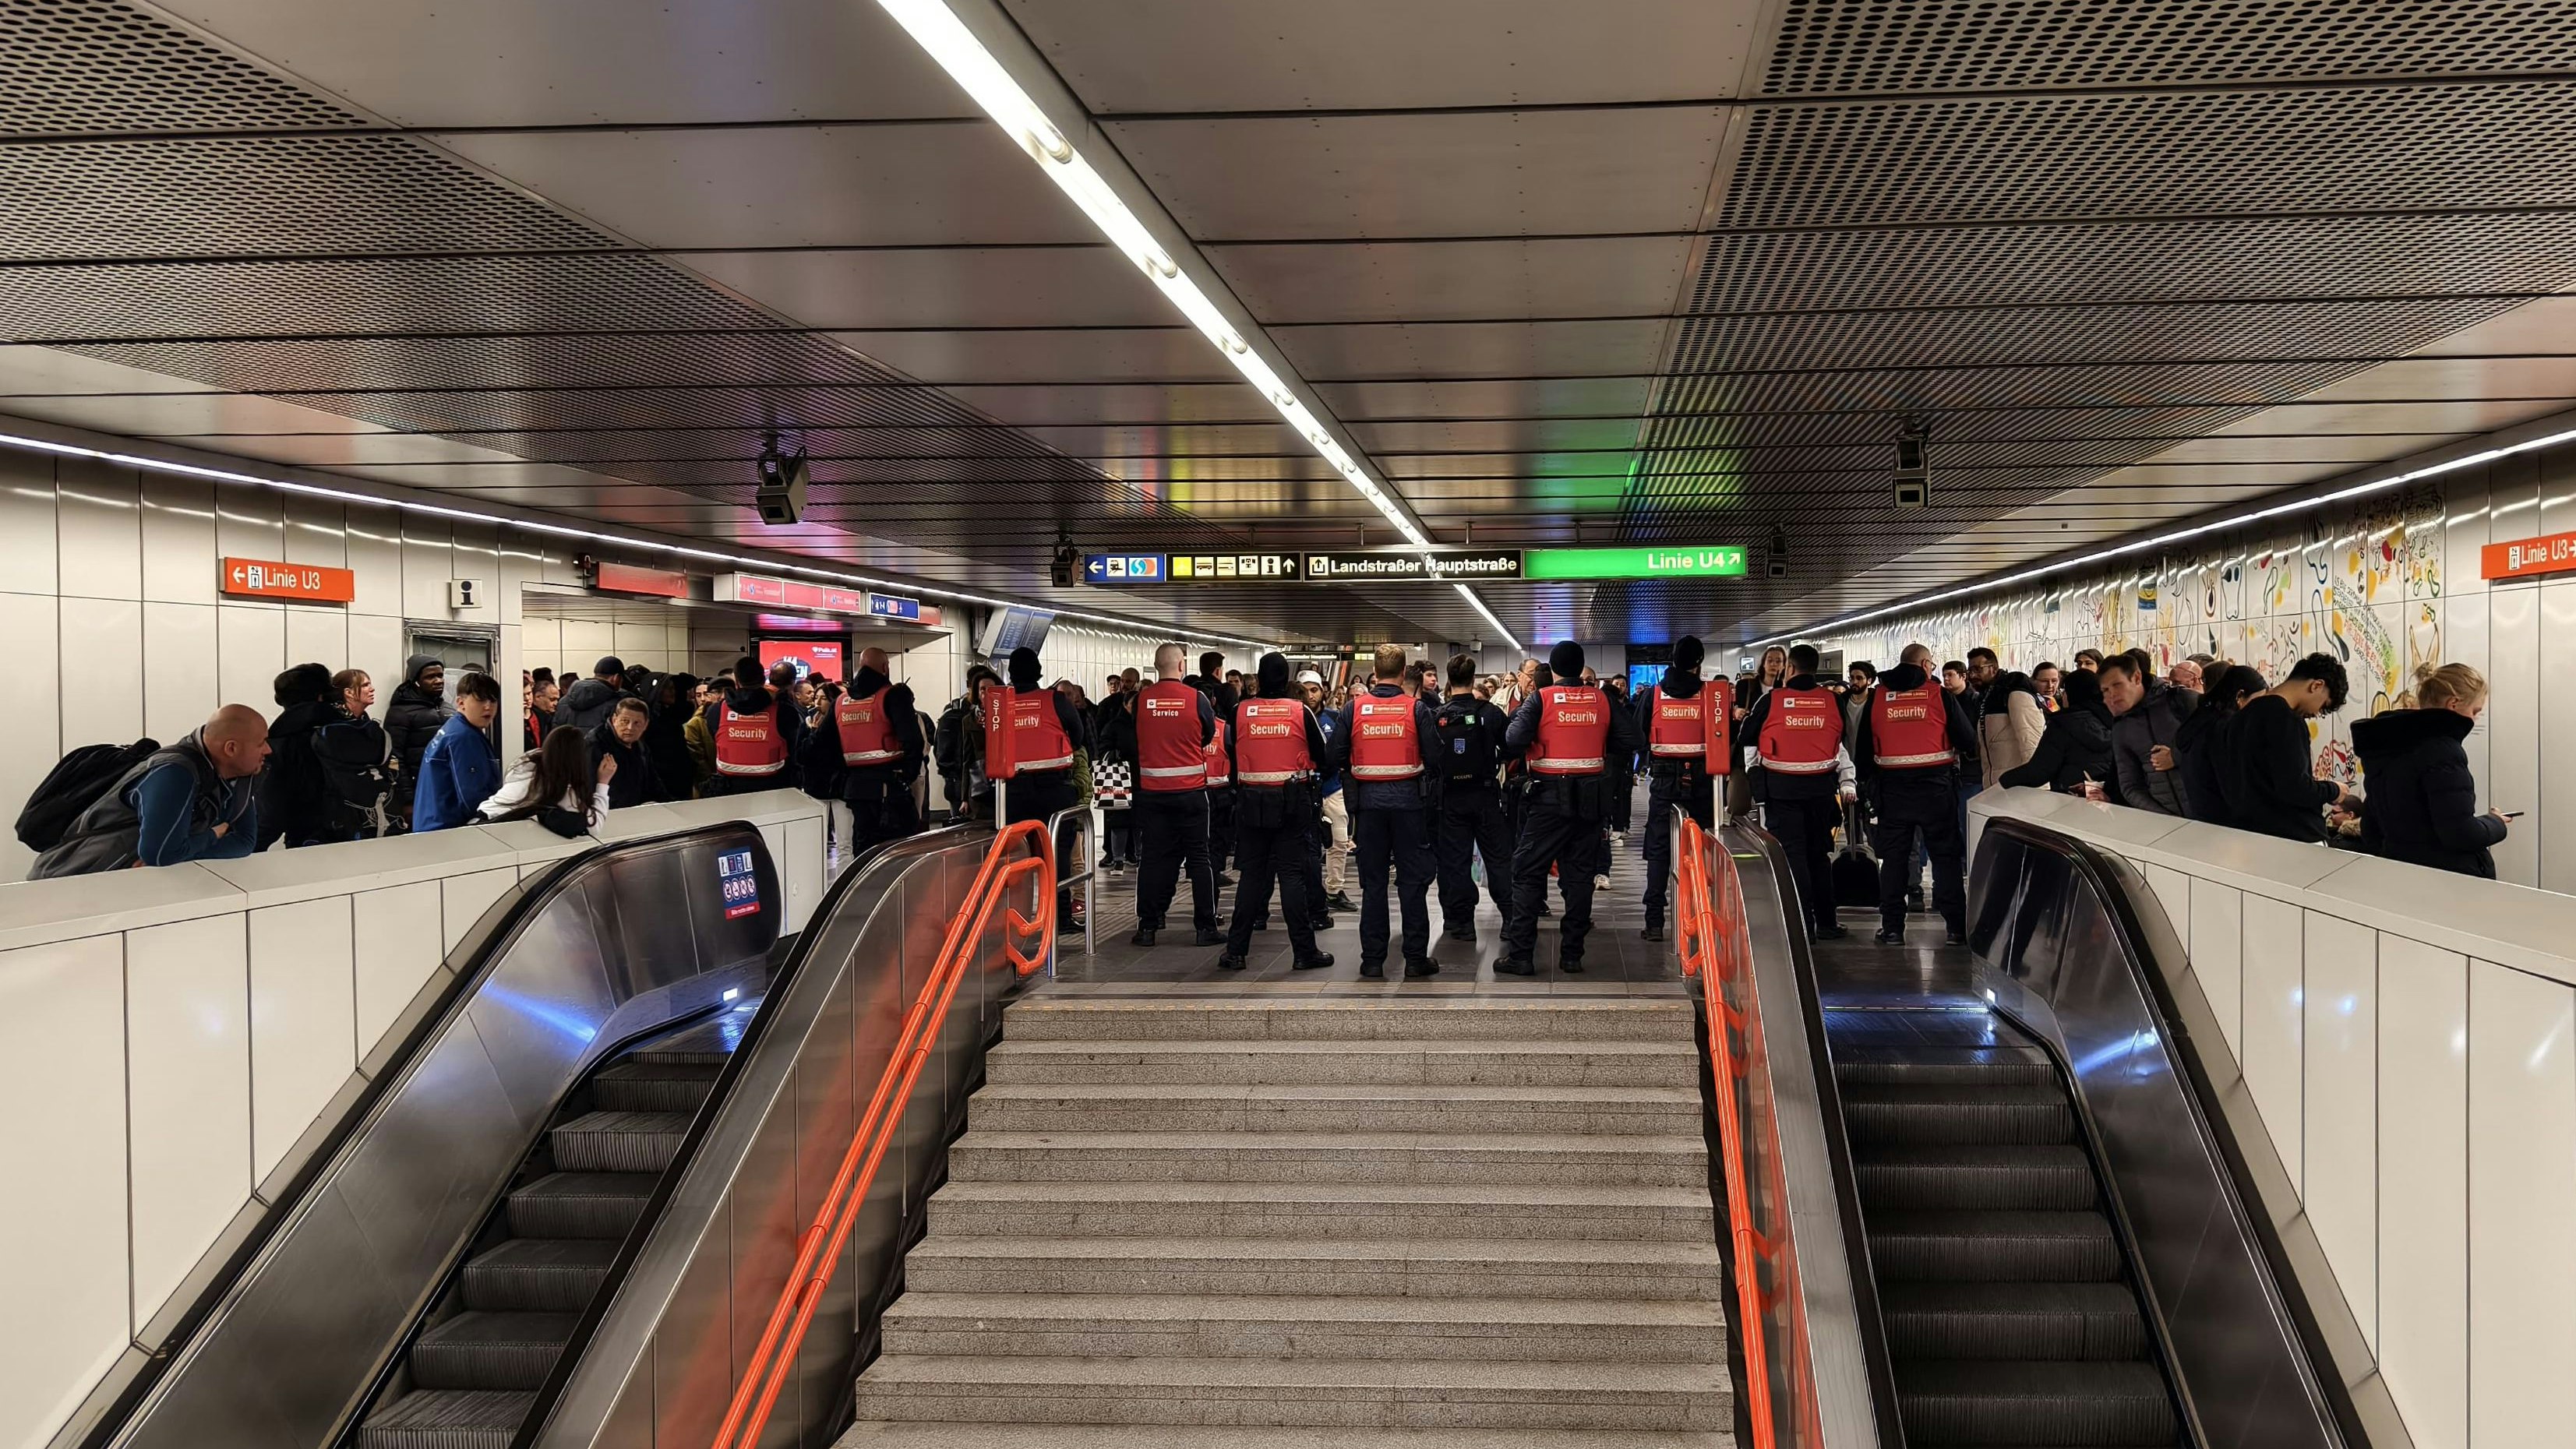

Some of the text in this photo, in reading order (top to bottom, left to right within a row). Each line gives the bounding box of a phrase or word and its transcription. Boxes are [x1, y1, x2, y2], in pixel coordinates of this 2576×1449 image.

[2521, 539, 2567, 565] Linie U3
[1331, 557, 1517, 574] Landstraßer Hauptstraße
[1648, 552, 1724, 569] Linie U4
[264, 567, 320, 590] Linie U3
[842, 710, 870, 722] Security
[1558, 710, 1597, 724] Security
[1662, 706, 1699, 718] Security
[1887, 706, 1926, 718] Security
[1015, 716, 1039, 727] curity
[1786, 715, 1824, 728] Security
[729, 727, 767, 740] Security
[1250, 723, 1290, 736] Security
[1363, 723, 1403, 737] Security
